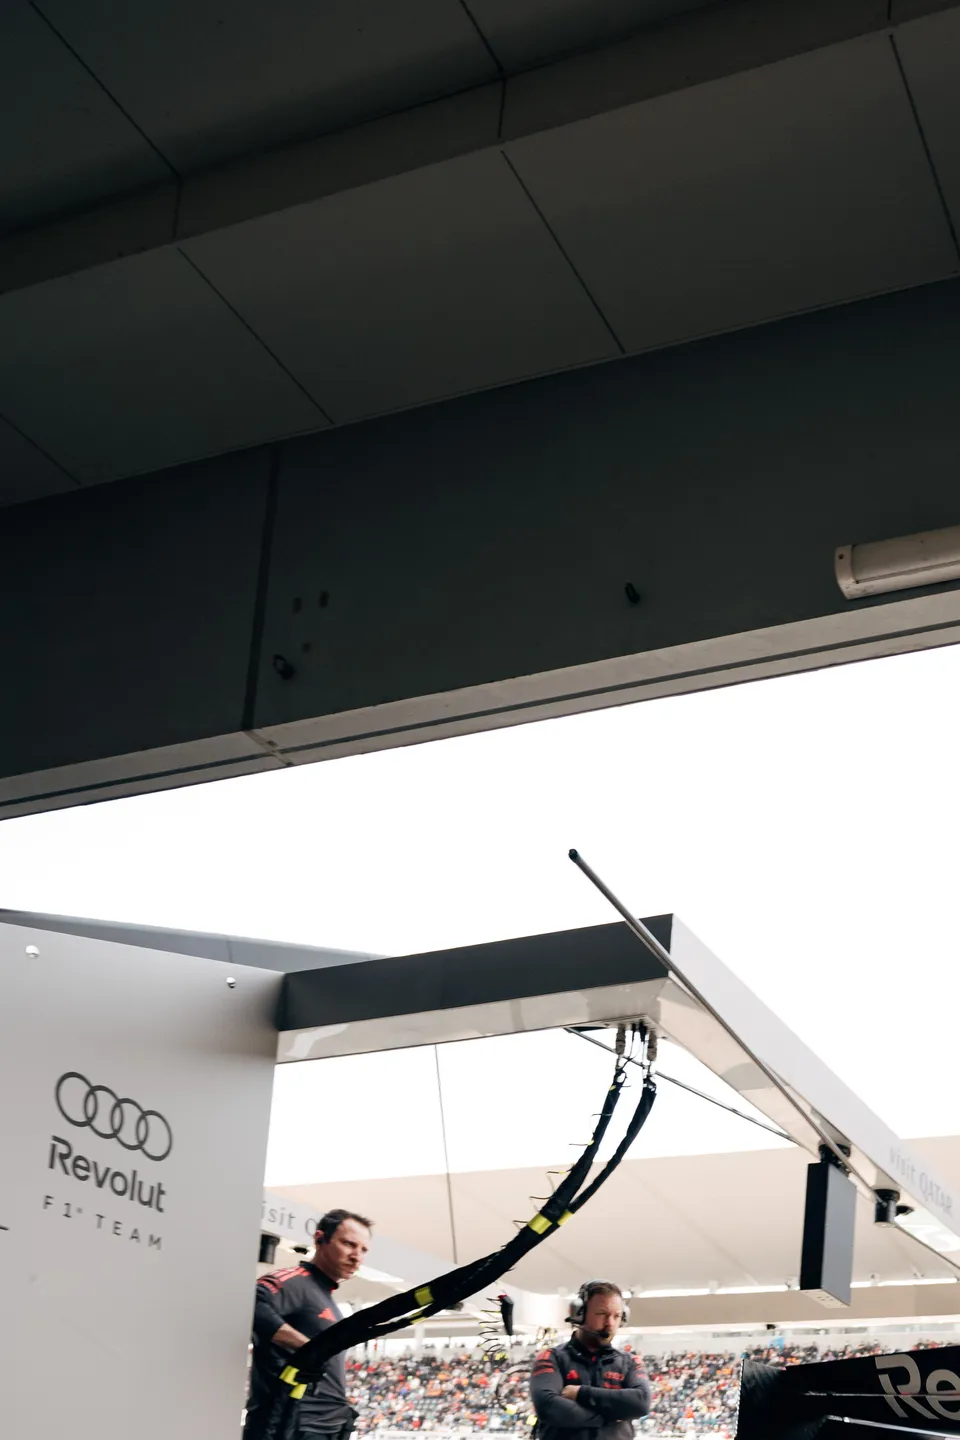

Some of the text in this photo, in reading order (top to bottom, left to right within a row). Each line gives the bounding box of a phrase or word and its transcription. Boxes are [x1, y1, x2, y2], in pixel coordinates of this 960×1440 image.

[48, 1135, 166, 1213] Revolut
[96, 1214, 161, 1250] TEAM
[261, 1201, 296, 1229] isit
